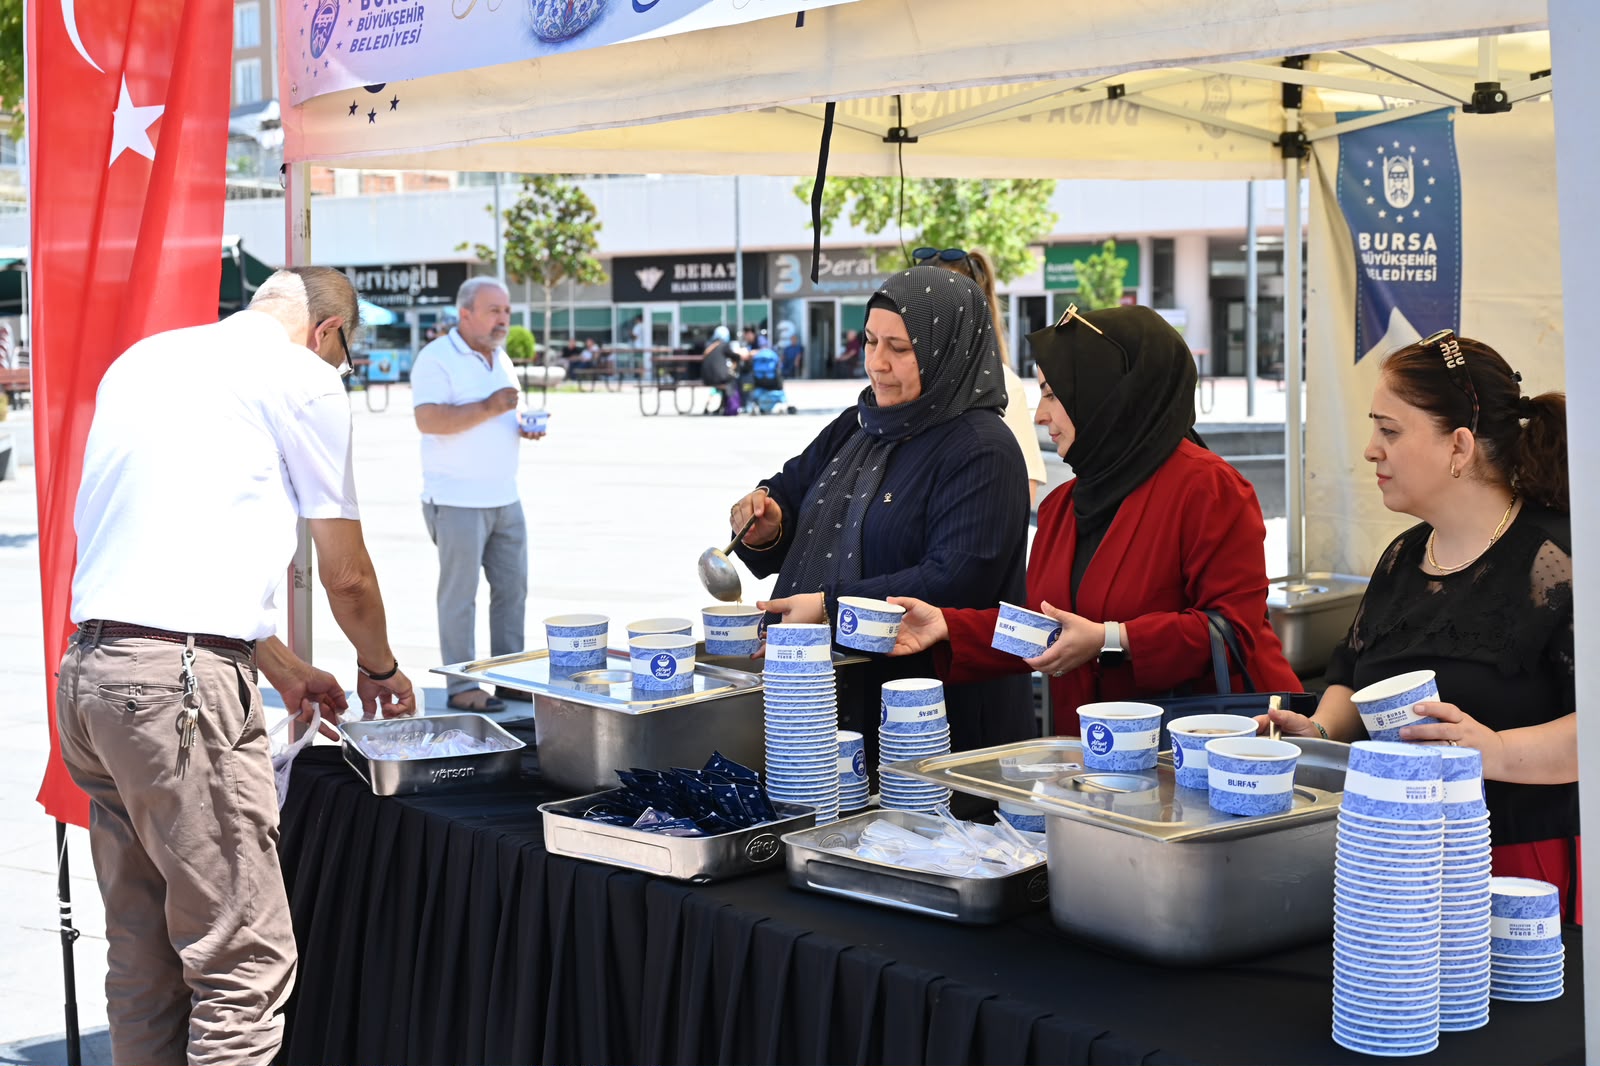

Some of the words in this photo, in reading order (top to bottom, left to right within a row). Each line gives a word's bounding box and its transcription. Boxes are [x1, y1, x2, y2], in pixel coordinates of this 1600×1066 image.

[356, 2, 425, 32] BÜYÜKŞEHİR
[349, 24, 423, 53] BELEDİYESİ
[1358, 232, 1438, 251] BURSA
[674, 263, 737, 279] BERAT
[1227, 778, 1257, 789] BURFAŞ
